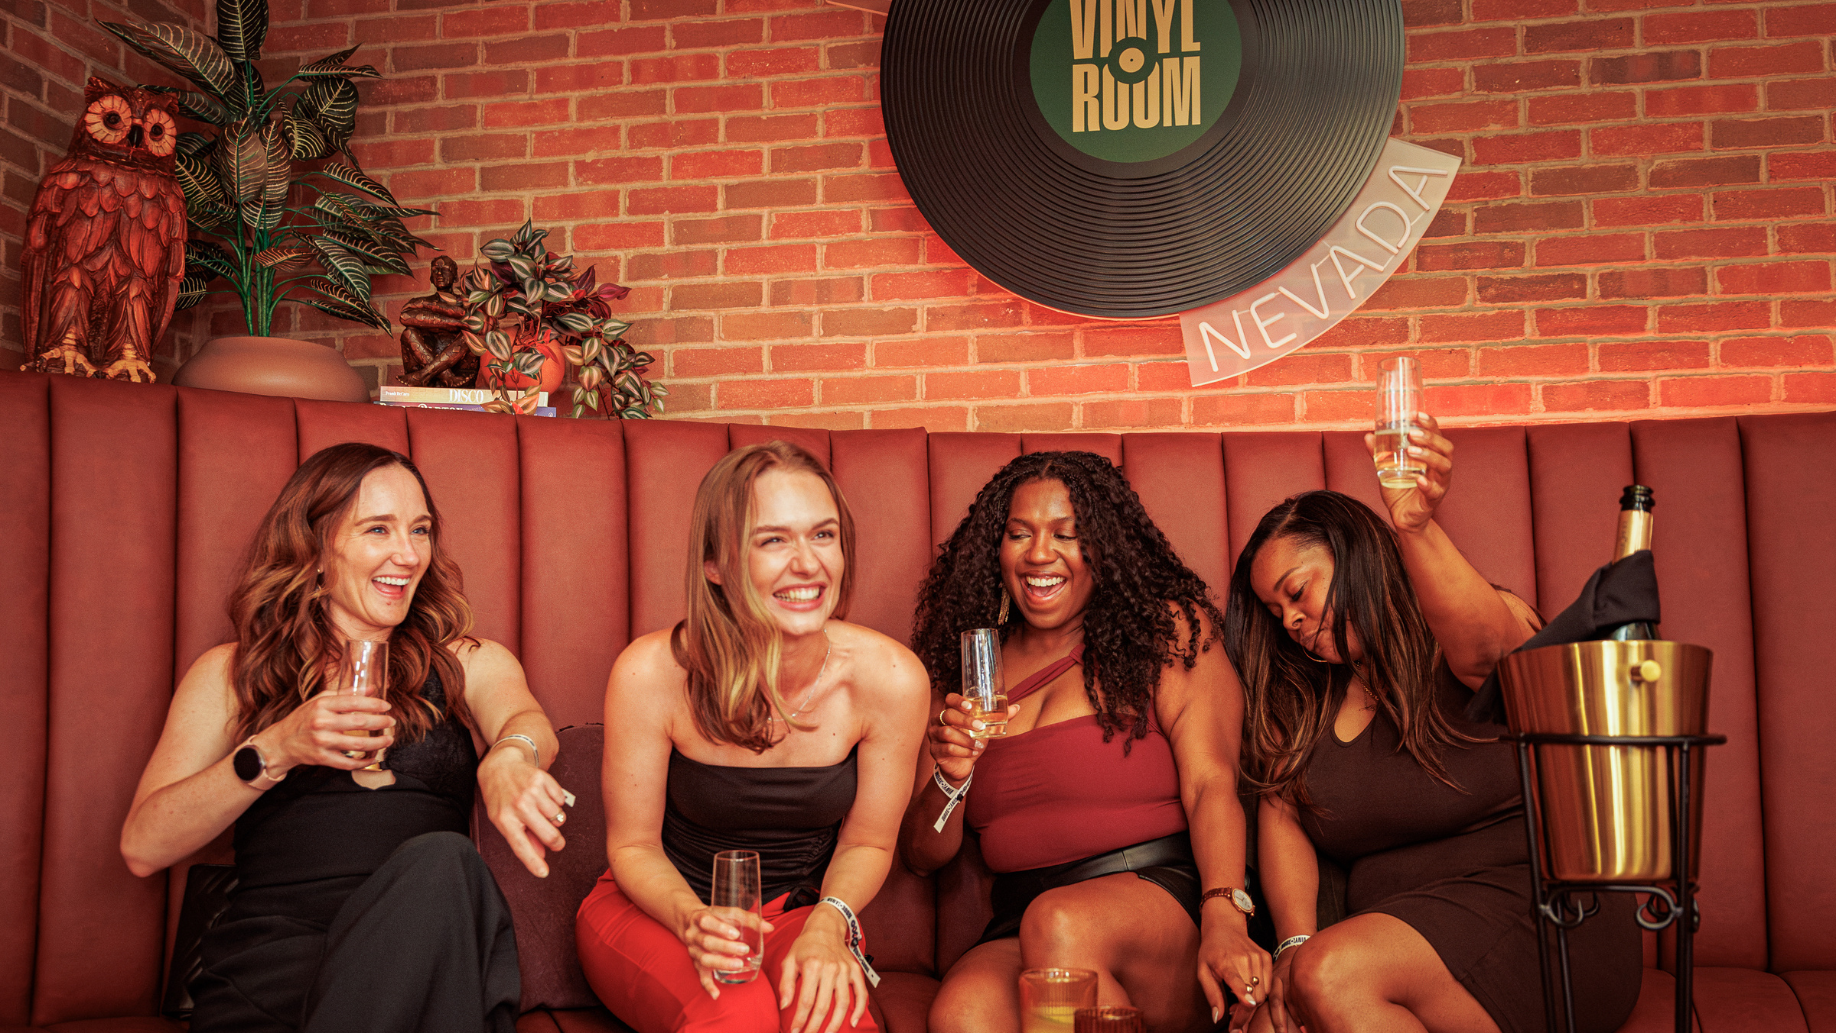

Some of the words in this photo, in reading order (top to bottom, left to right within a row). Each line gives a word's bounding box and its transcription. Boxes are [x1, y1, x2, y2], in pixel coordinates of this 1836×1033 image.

[1070, 0, 1201, 60] VINYL
[1072, 55, 1202, 133] ROOM
[1199, 165, 1449, 372] NEVADA
[449, 389, 484, 404] DISCO
